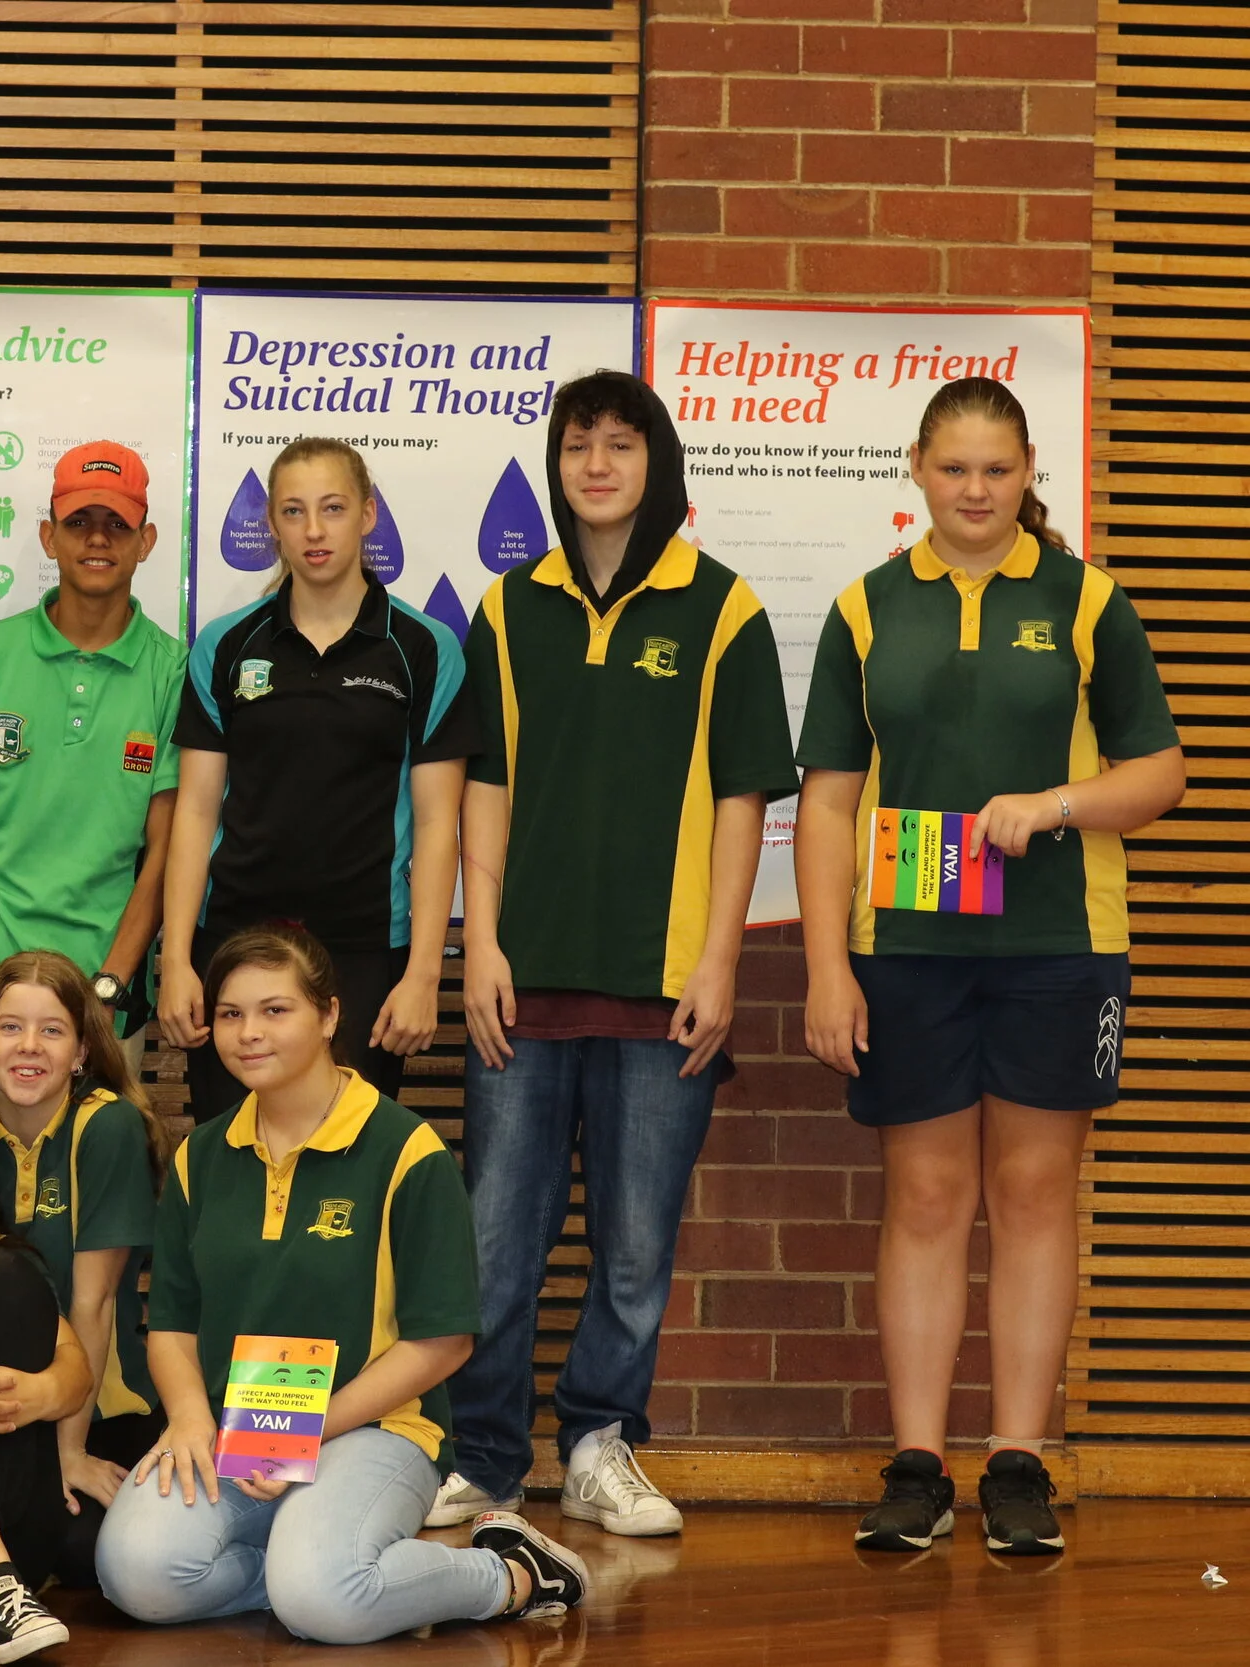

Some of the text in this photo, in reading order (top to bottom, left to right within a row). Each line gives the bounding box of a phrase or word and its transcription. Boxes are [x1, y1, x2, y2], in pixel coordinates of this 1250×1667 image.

[222, 330, 551, 375] Depression and
[675, 341, 1019, 389] Helping a friend
[223, 375, 393, 413] Suicidal
[677, 385, 830, 424] in need
[62, 436, 83, 447] drink
[222, 432, 438, 450] If you are dssed you may:
[38, 448, 62, 459] drugs
[712, 443, 730, 455] do
[734, 446, 761, 459] you
[765, 444, 804, 456] know
[808, 445, 819, 457] if
[821, 448, 854, 460] your
[859, 445, 902, 458] friend
[82, 461, 121, 474] Supreme
[689, 464, 898, 481] friend who is not feeling well
[243, 520, 259, 528] Feel
[230, 531, 263, 540] hopeless
[503, 530, 524, 540] Sleep
[236, 541, 266, 549] helpless
[364, 543, 384, 551] Have
[717, 539, 742, 548] Change
[779, 541, 792, 549] very
[793, 540, 809, 548] often
[376, 553, 390, 561] low
[512, 551, 529, 559] little
[124, 761, 151, 773] GROW
[771, 805, 799, 814] serio
[944, 844, 959, 883] YAM
[921, 874, 929, 900] AFFECT
[236, 1390, 315, 1401] AFFECT AND IMPROVE
[291, 1400, 308, 1408] FEEL
[251, 1413, 292, 1431] YAM
